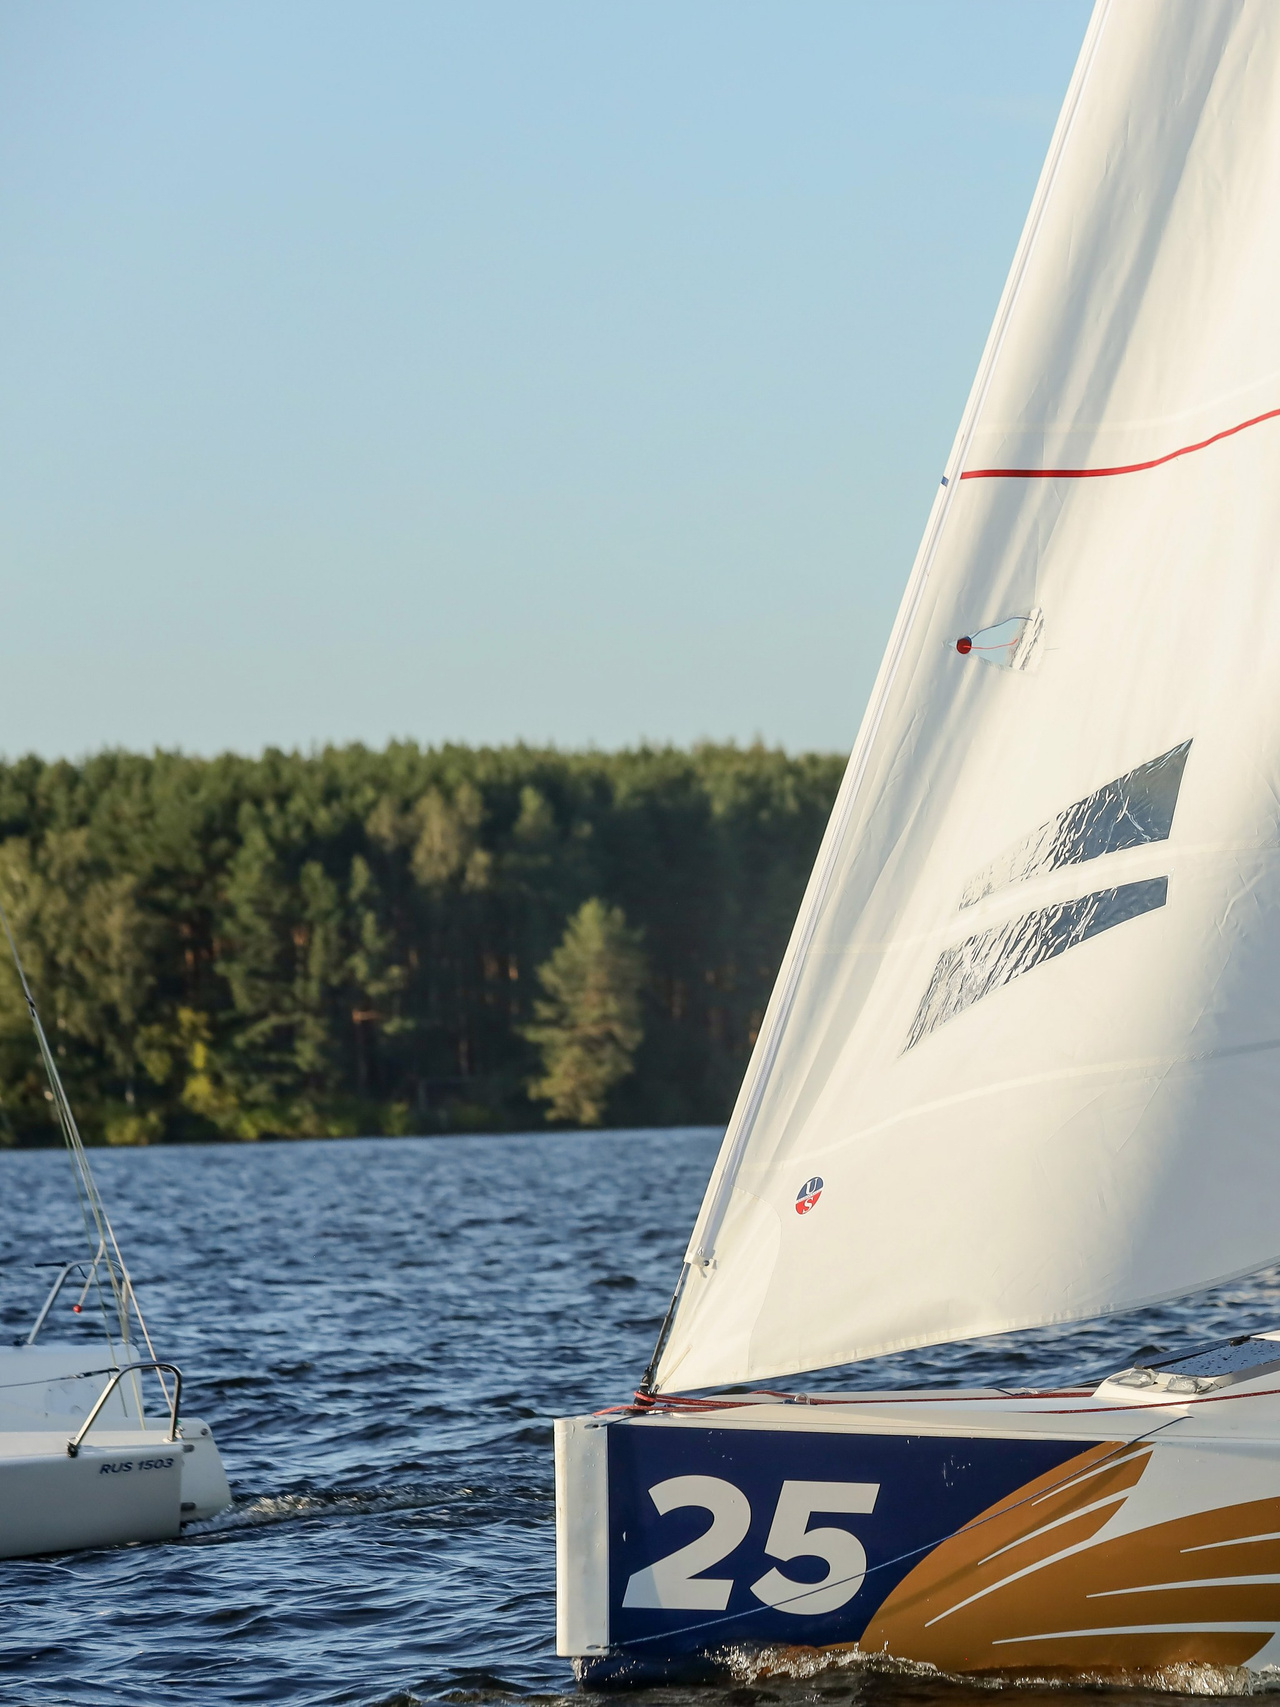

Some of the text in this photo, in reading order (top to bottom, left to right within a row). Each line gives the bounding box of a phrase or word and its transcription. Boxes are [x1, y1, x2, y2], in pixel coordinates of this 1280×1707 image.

[99, 1458, 175, 1474] RUS 1503
[621, 1474, 881, 1616] 25
